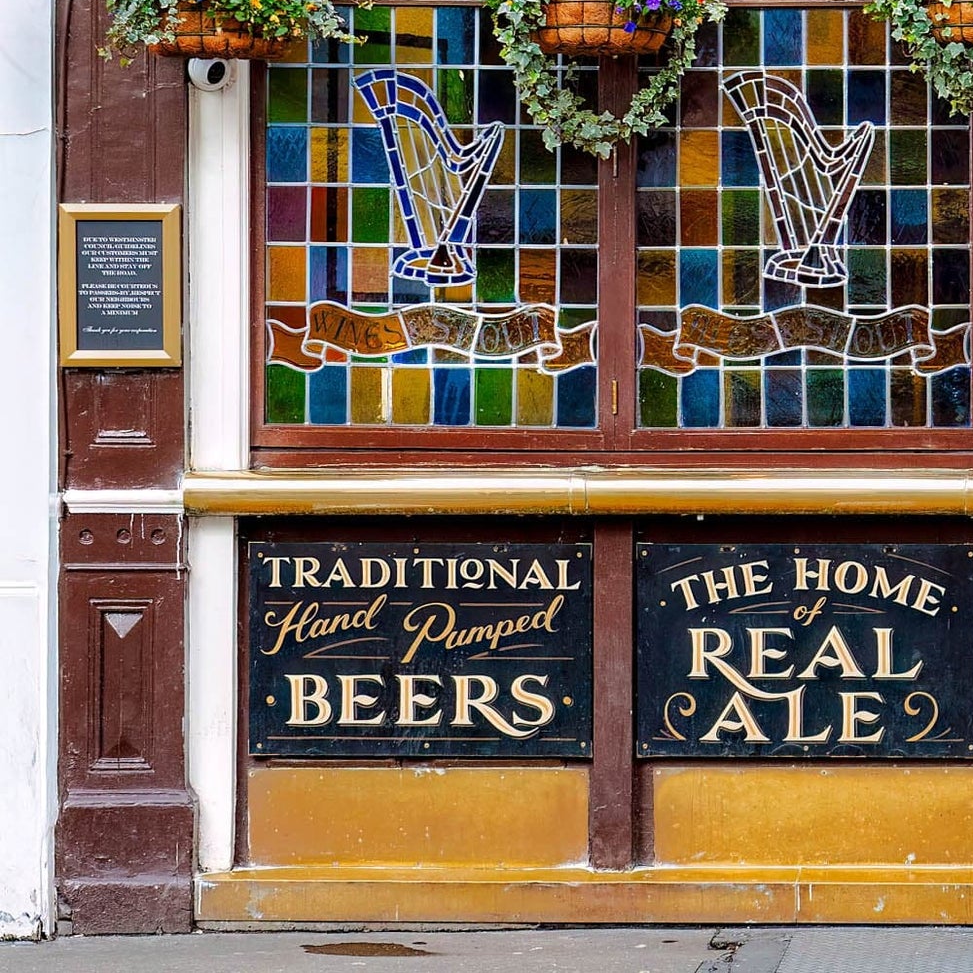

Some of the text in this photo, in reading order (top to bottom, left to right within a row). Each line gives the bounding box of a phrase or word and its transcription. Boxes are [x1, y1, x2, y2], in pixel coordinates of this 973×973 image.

[313, 313, 403, 349] WINES
[263, 557, 581, 590] TRADITIONAL
[671, 558, 946, 616] THE HOME
[260, 594, 564, 664] Hand Pumped
[793, 597, 827, 626] of
[687, 626, 923, 700] REAL
[285, 674, 554, 739] BEERS
[699, 686, 885, 743] ALE
